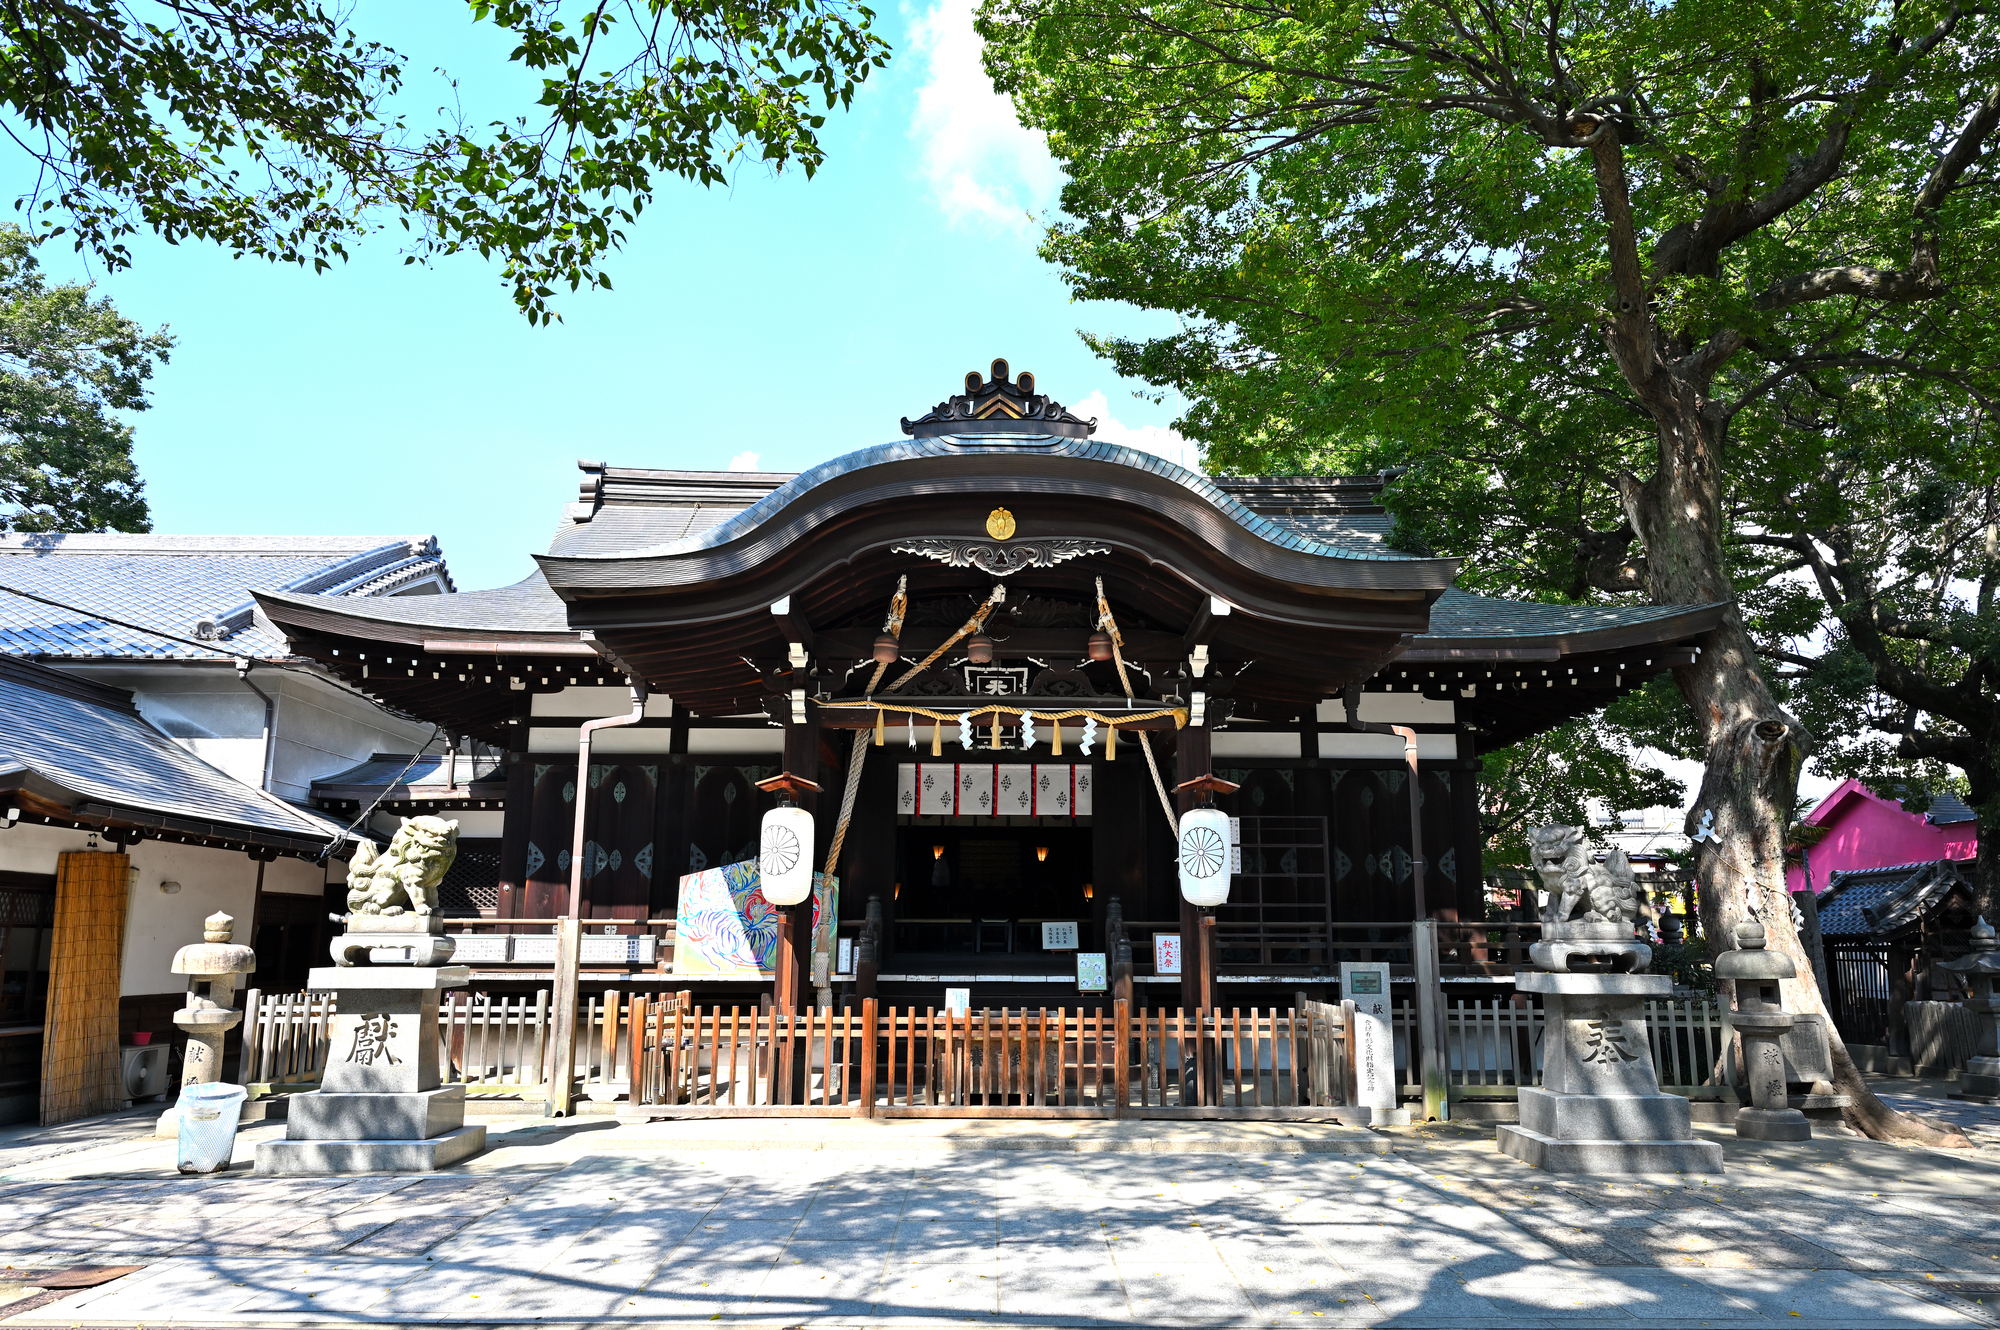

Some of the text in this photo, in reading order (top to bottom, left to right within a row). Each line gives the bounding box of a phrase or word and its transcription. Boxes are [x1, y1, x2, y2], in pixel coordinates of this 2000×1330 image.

[1162, 939, 1173, 968] 秋大祭
[1582, 1011, 1639, 1074] 奉
